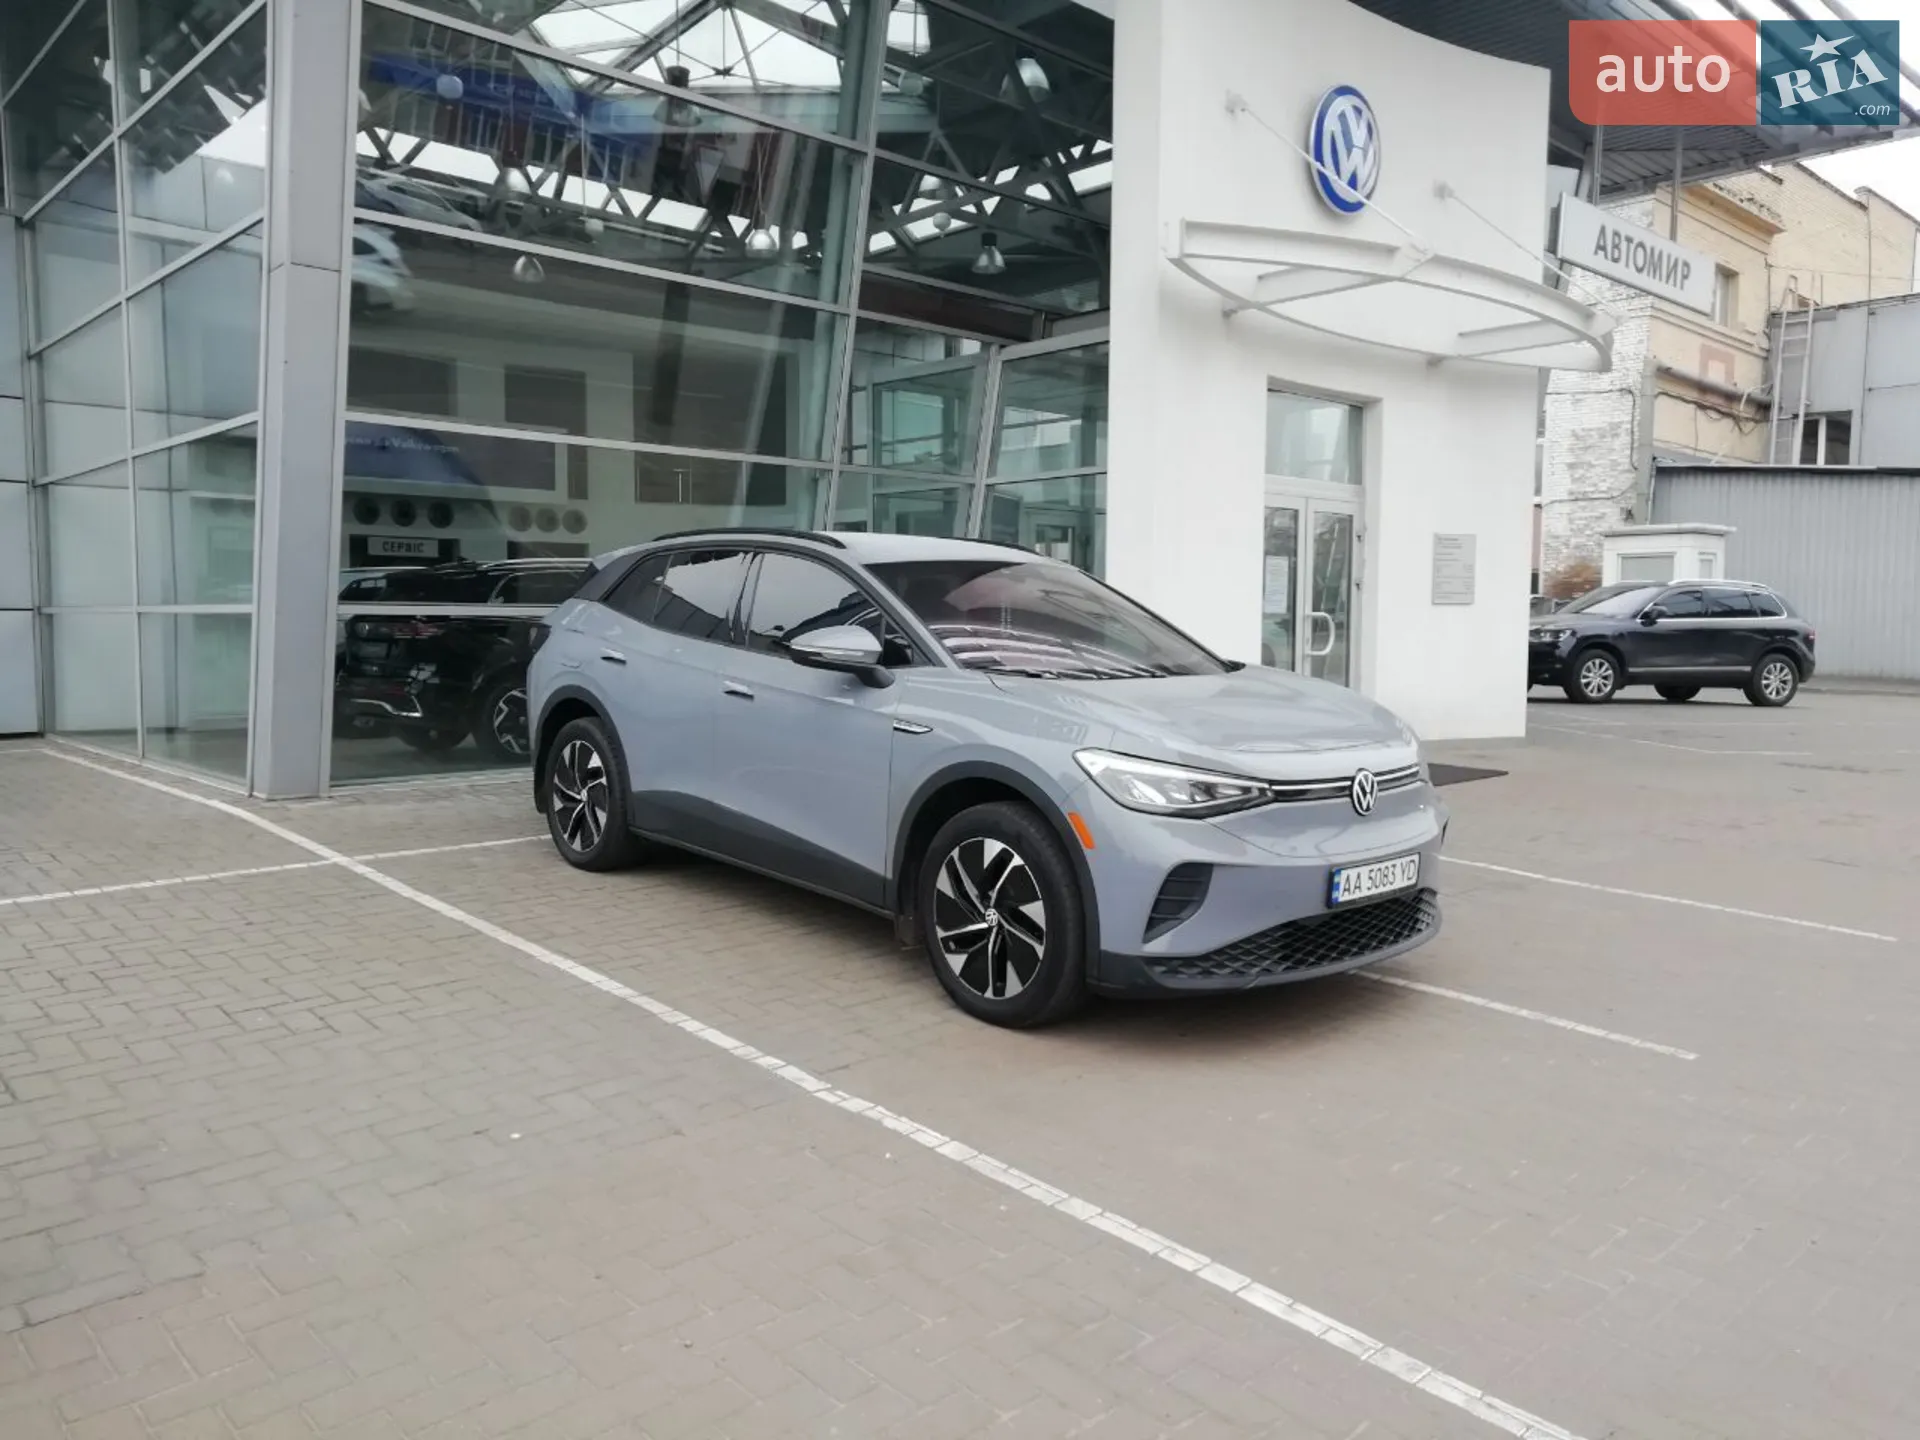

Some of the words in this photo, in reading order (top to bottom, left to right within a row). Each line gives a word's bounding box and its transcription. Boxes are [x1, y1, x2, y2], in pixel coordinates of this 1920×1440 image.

[1593, 223, 1692, 291] АВТОМИР
[1342, 874, 1361, 897] AA
[1367, 864, 1397, 891] 5083
